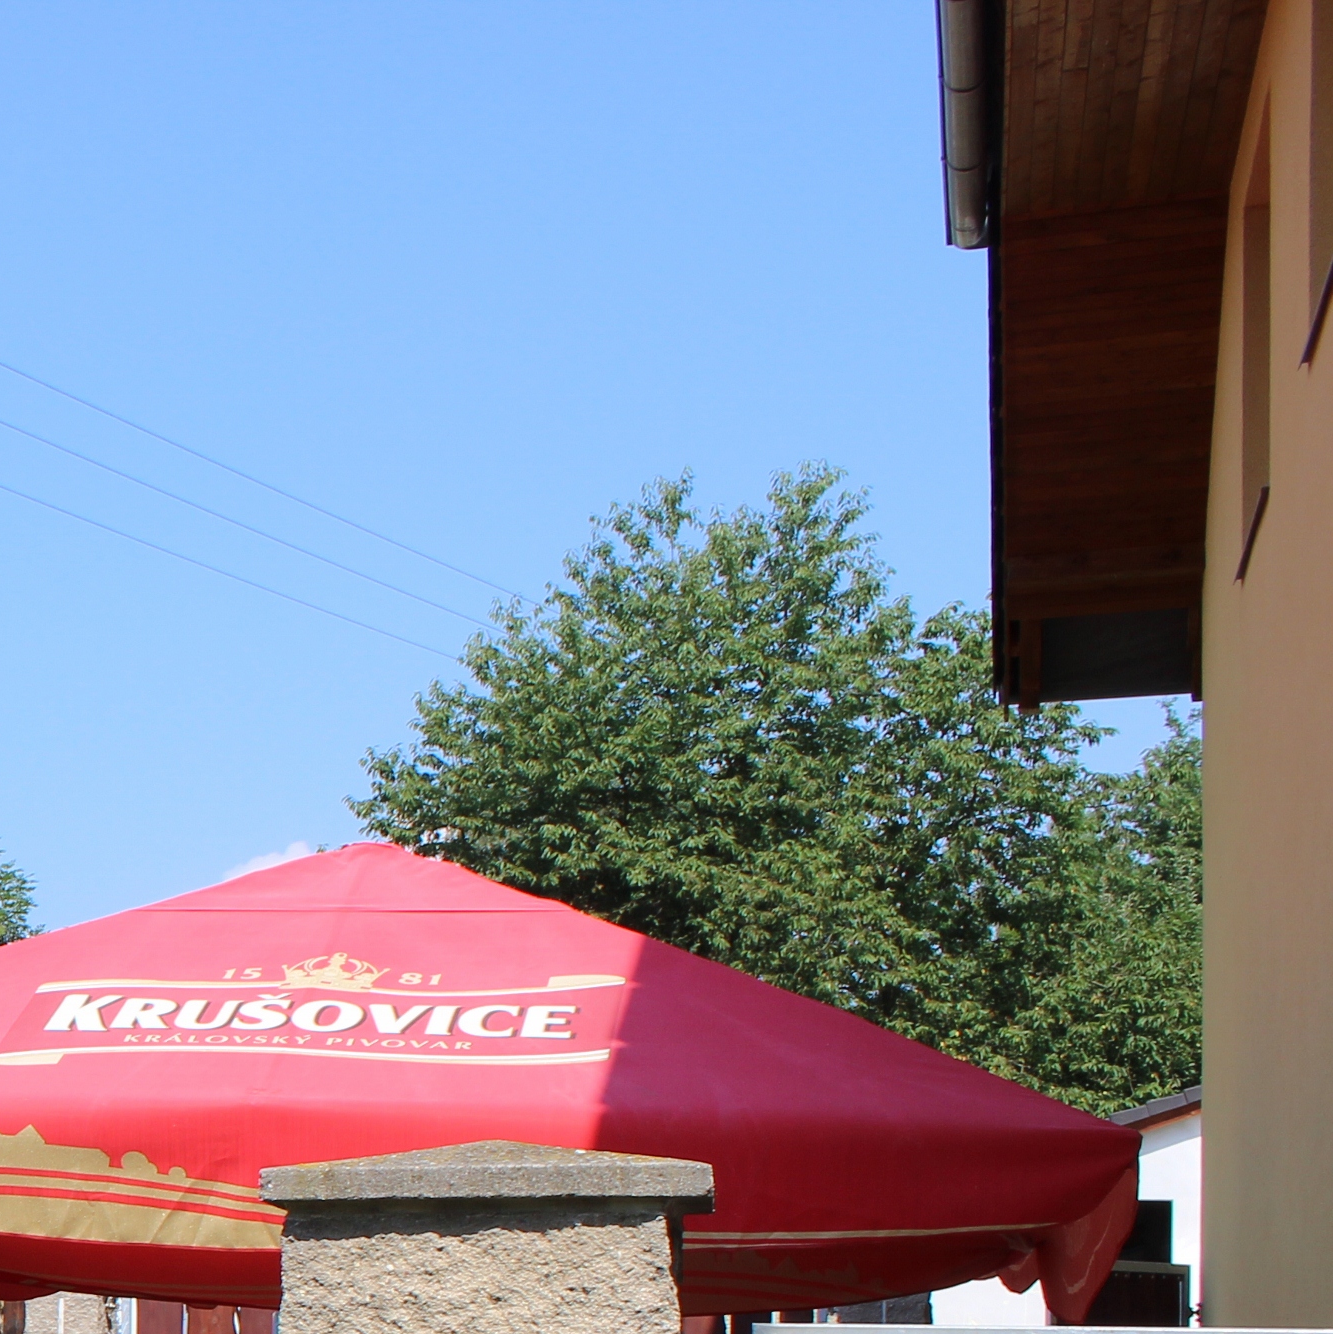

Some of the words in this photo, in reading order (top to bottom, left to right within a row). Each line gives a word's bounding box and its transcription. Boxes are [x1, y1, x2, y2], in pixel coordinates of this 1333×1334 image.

[222, 967, 263, 980] 15
[398, 972, 442, 986] 81
[42, 992, 580, 1040] KRUŠOVICE
[122, 1033, 313, 1045] KRÁLOVSKÝ
[325, 1037, 473, 1050] PIVOVAR
